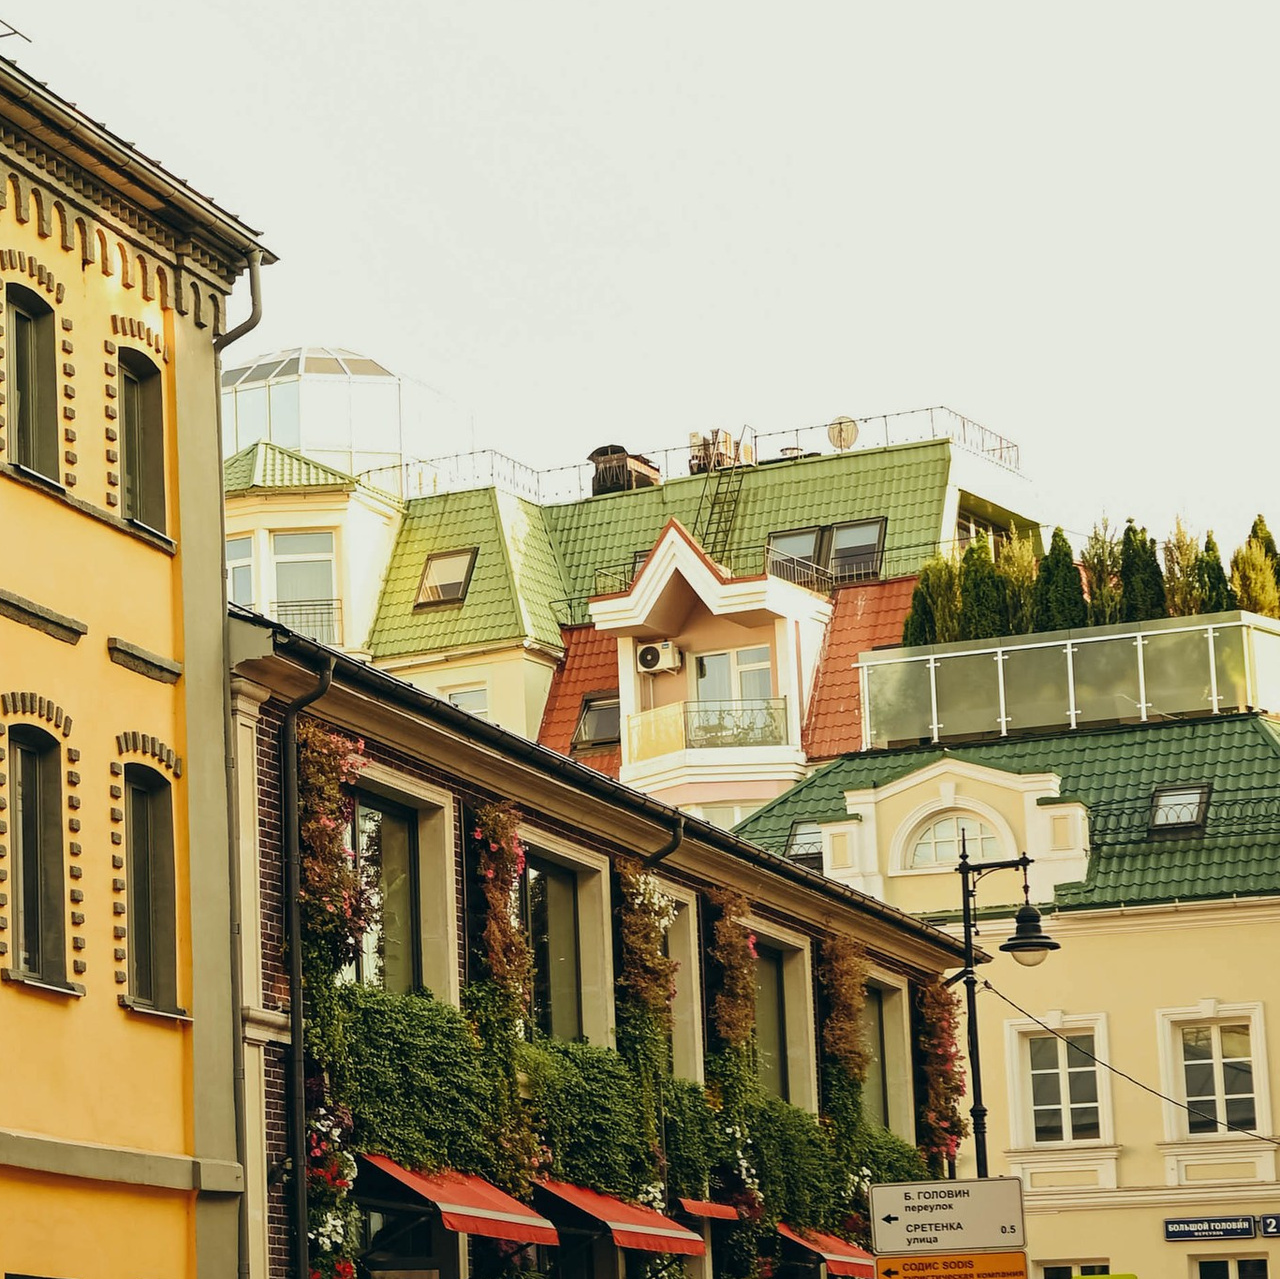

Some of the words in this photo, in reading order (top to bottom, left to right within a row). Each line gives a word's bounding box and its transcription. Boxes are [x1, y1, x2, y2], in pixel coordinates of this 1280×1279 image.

[904, 1192, 915, 1201] Б.
[917, 1189, 970, 1200] ГОЛОВИН
[904, 1203, 954, 1213] переулок
[906, 1222, 963, 1233] СРЕТЕНКА
[1000, 1225, 1016, 1234] 0.5
[1168, 1222, 1209, 1232] БОЛЬШОЙ
[906, 1236, 938, 1246] улица
[902, 1261, 939, 1272] СОДИС
[942, 1260, 974, 1271] SODIS
[977, 1269, 1024, 1279] компания
